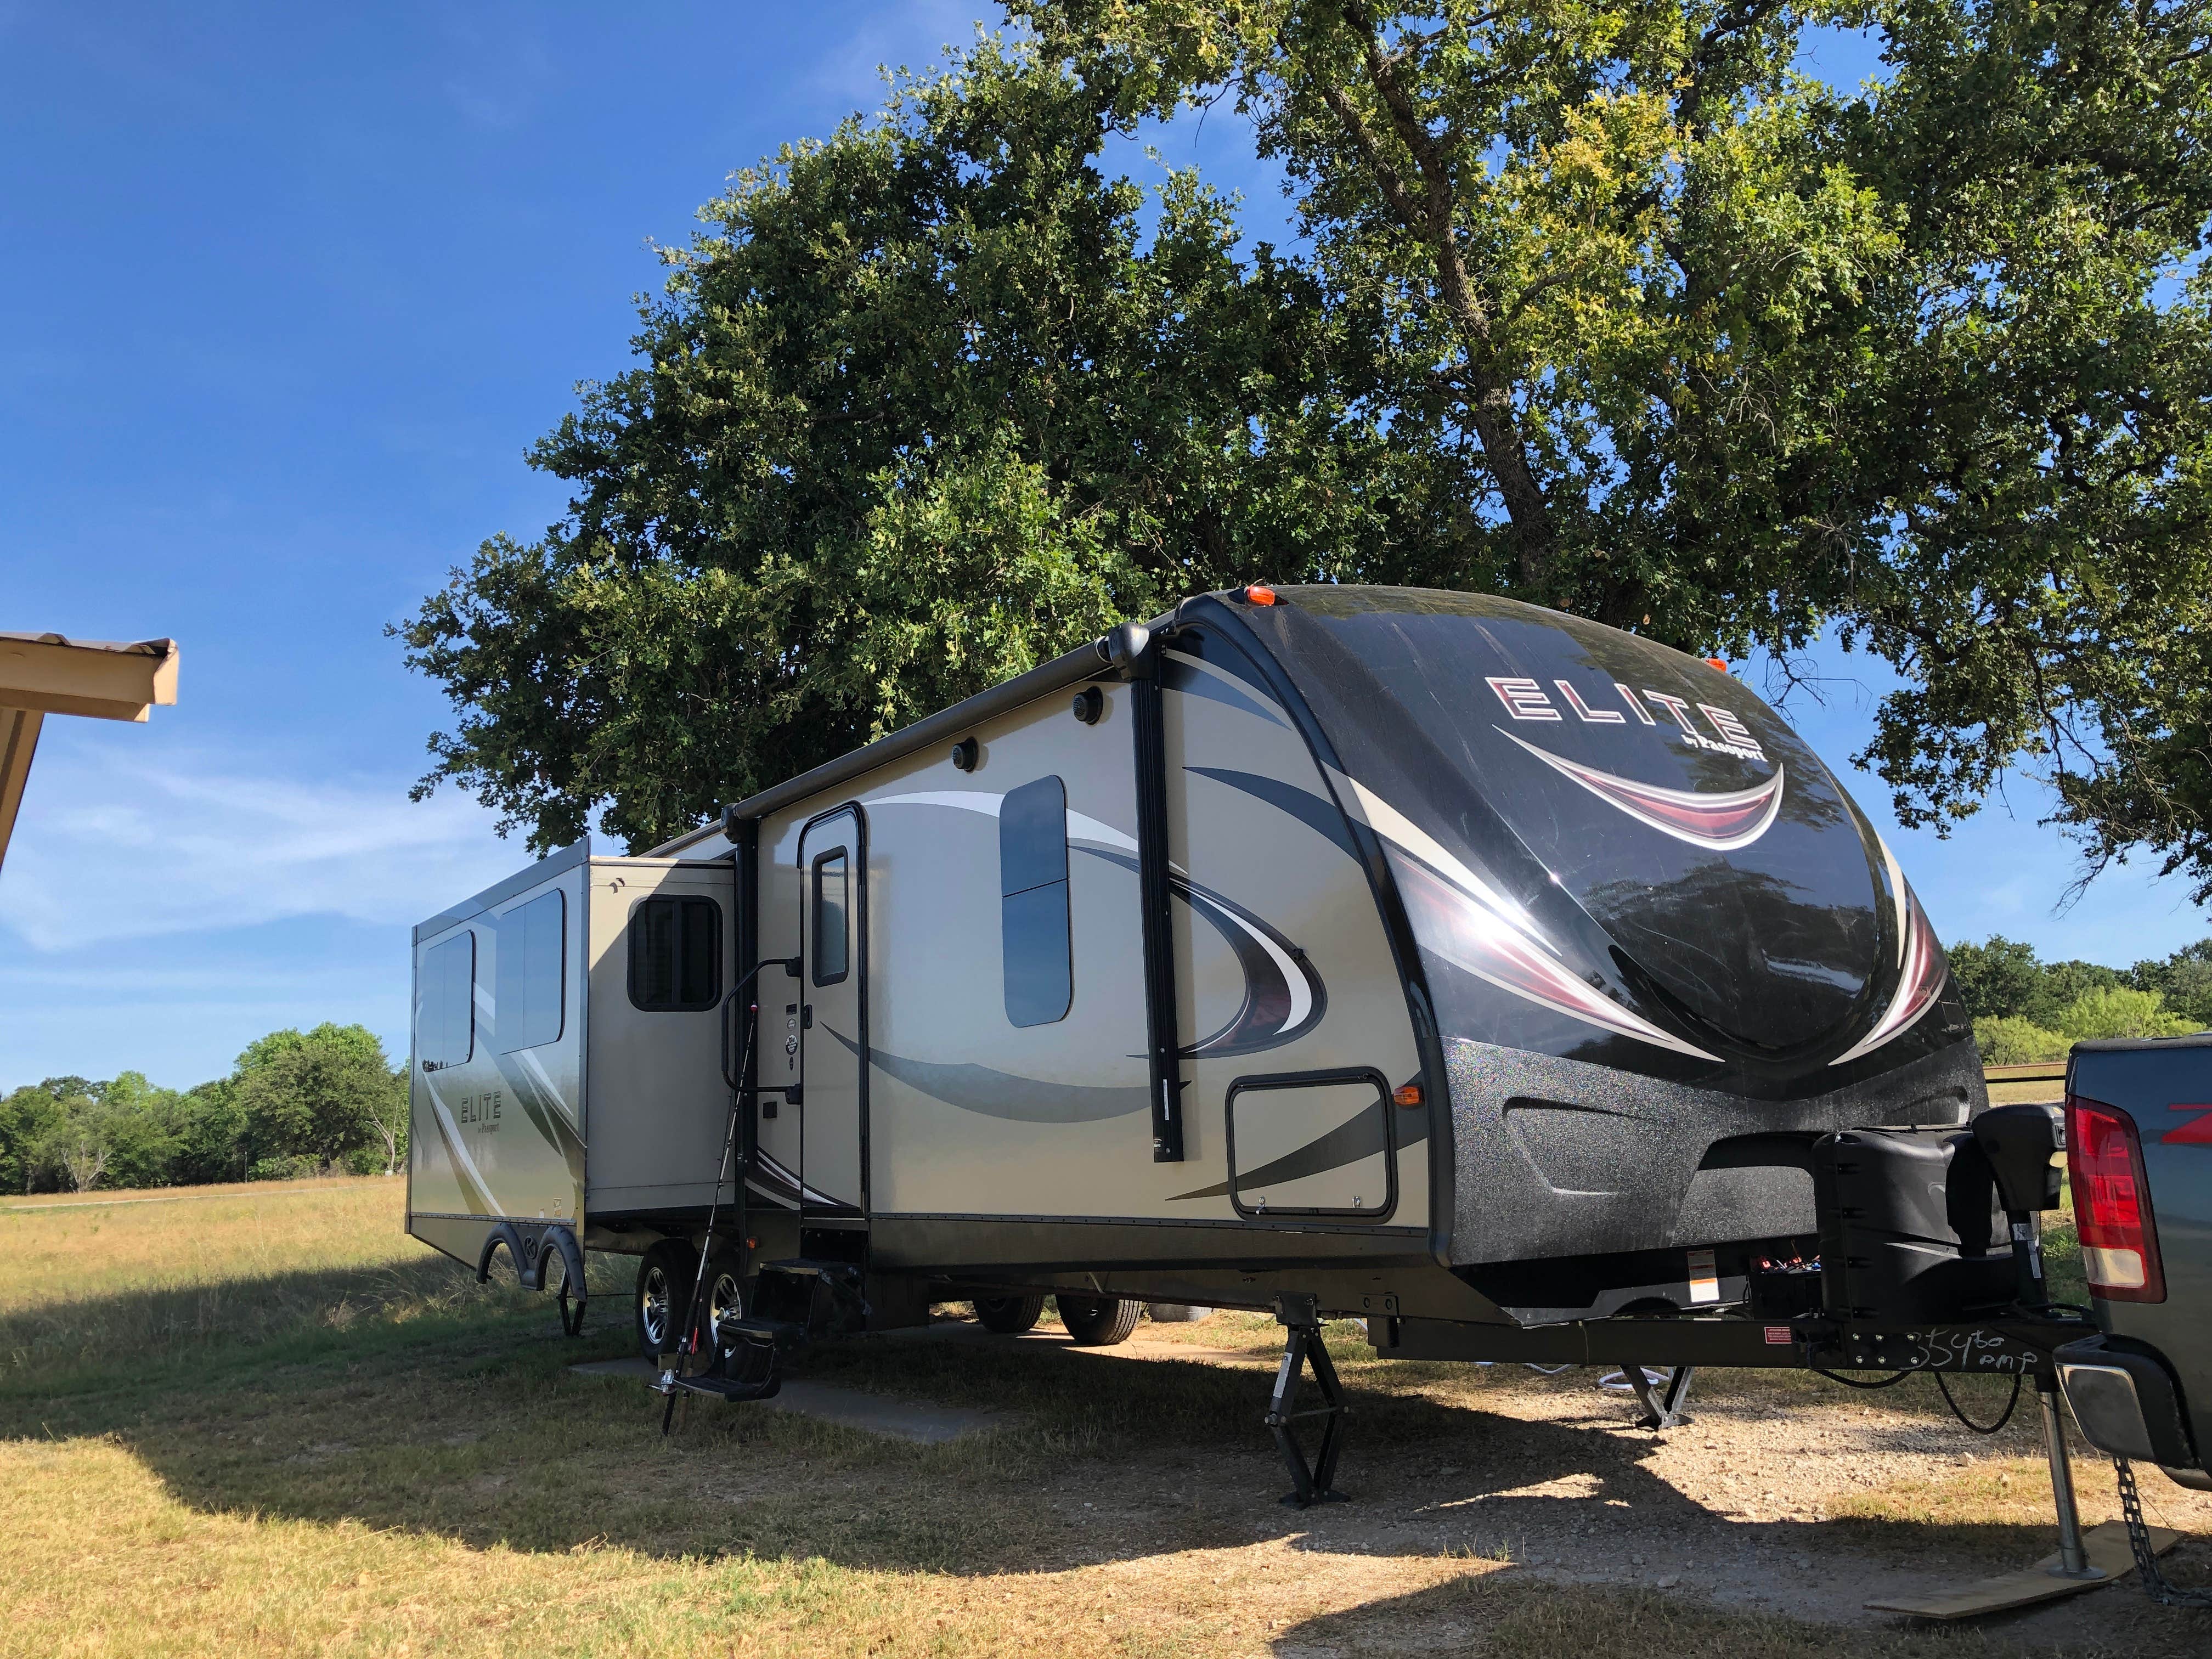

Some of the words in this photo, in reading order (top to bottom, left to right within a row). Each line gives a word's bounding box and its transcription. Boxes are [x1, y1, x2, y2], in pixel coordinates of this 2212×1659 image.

[1485, 676, 1762, 751] ELITE
[1681, 734, 1699, 748] by
[1694, 734, 1769, 763] Passport
[461, 1091, 501, 1124] ELITE
